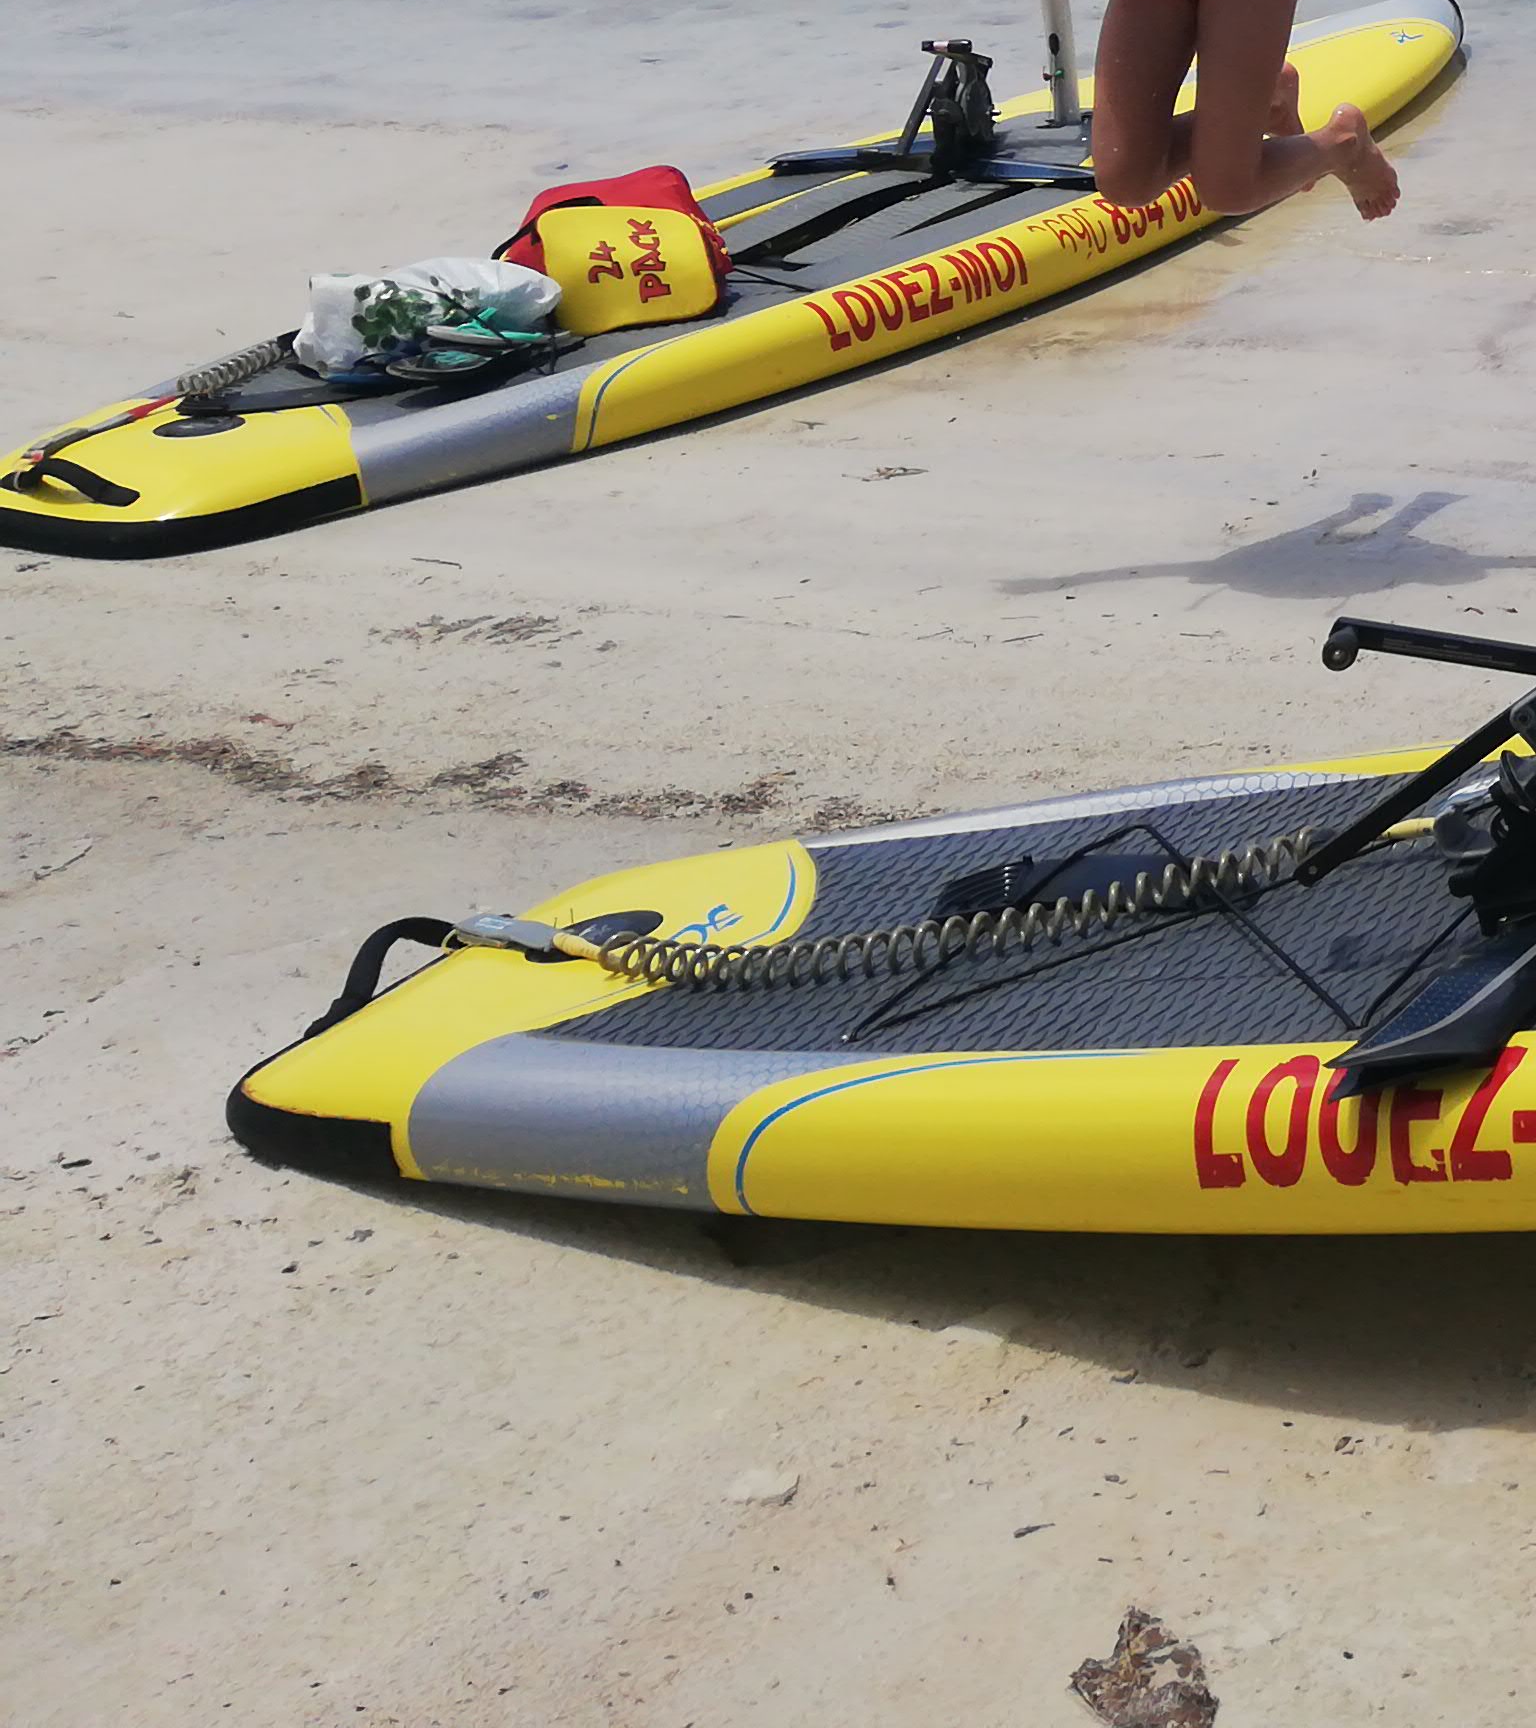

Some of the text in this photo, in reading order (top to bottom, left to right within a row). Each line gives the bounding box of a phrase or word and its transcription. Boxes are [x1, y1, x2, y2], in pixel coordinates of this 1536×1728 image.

[588, 240, 624, 284] 24
[626, 218, 672, 304] PACK
[802, 236, 1028, 352] LOUEZ-MOI
